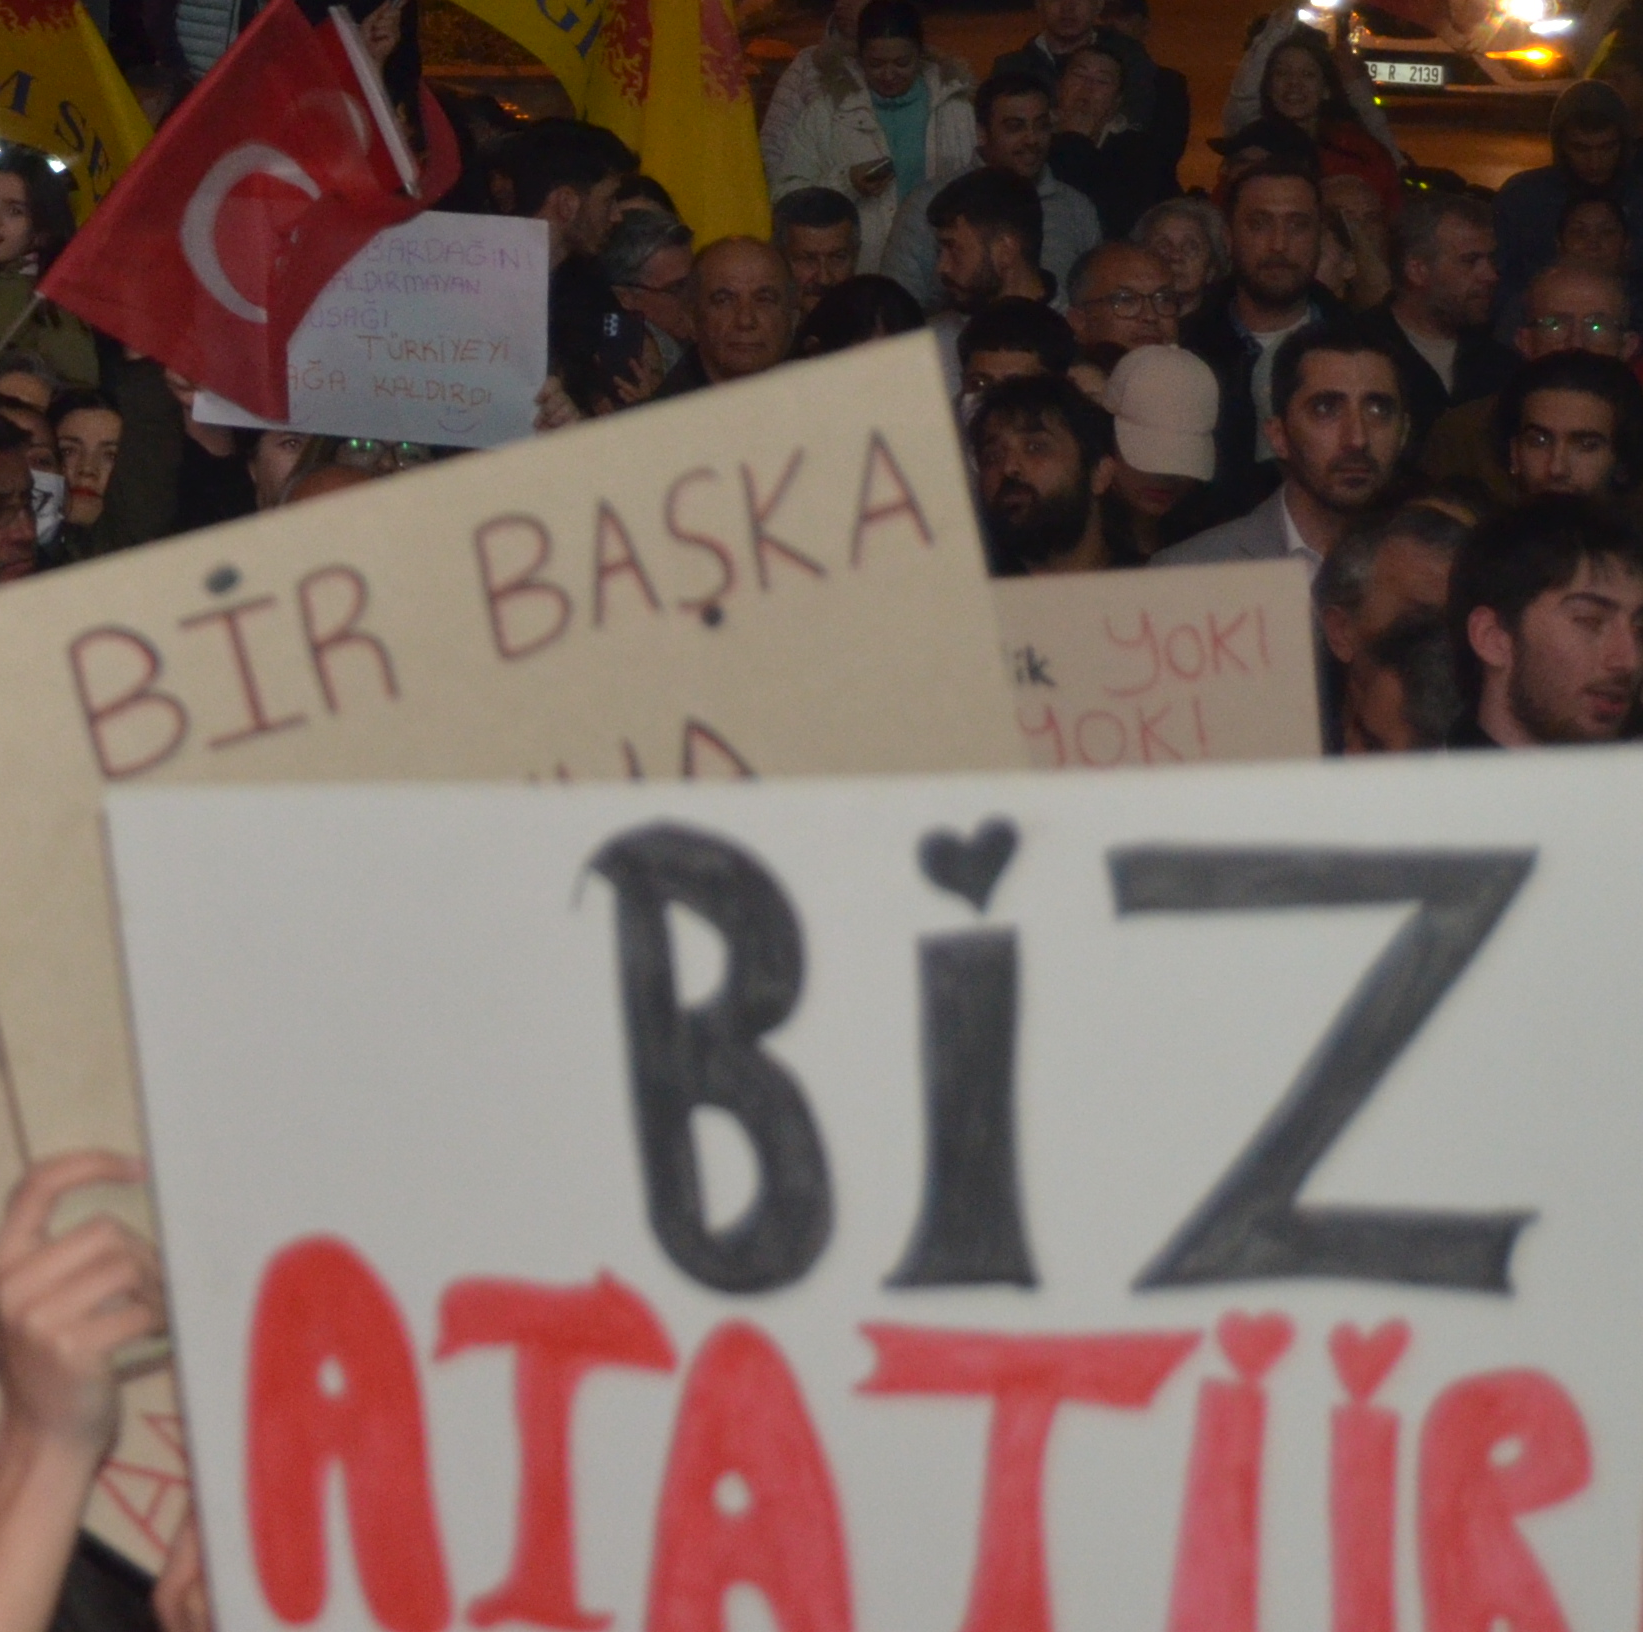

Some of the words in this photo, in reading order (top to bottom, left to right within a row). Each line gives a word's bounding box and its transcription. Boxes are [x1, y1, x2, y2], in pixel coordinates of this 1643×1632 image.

[1388, 65, 1397, 81] R
[1409, 66, 1440, 84] 2139
[67, 563, 401, 782] BİR
[471, 424, 938, 662] BAŞKA
[573, 810, 1542, 1298] BİZ
[242, 1229, 1643, 1632] ATATÜR
